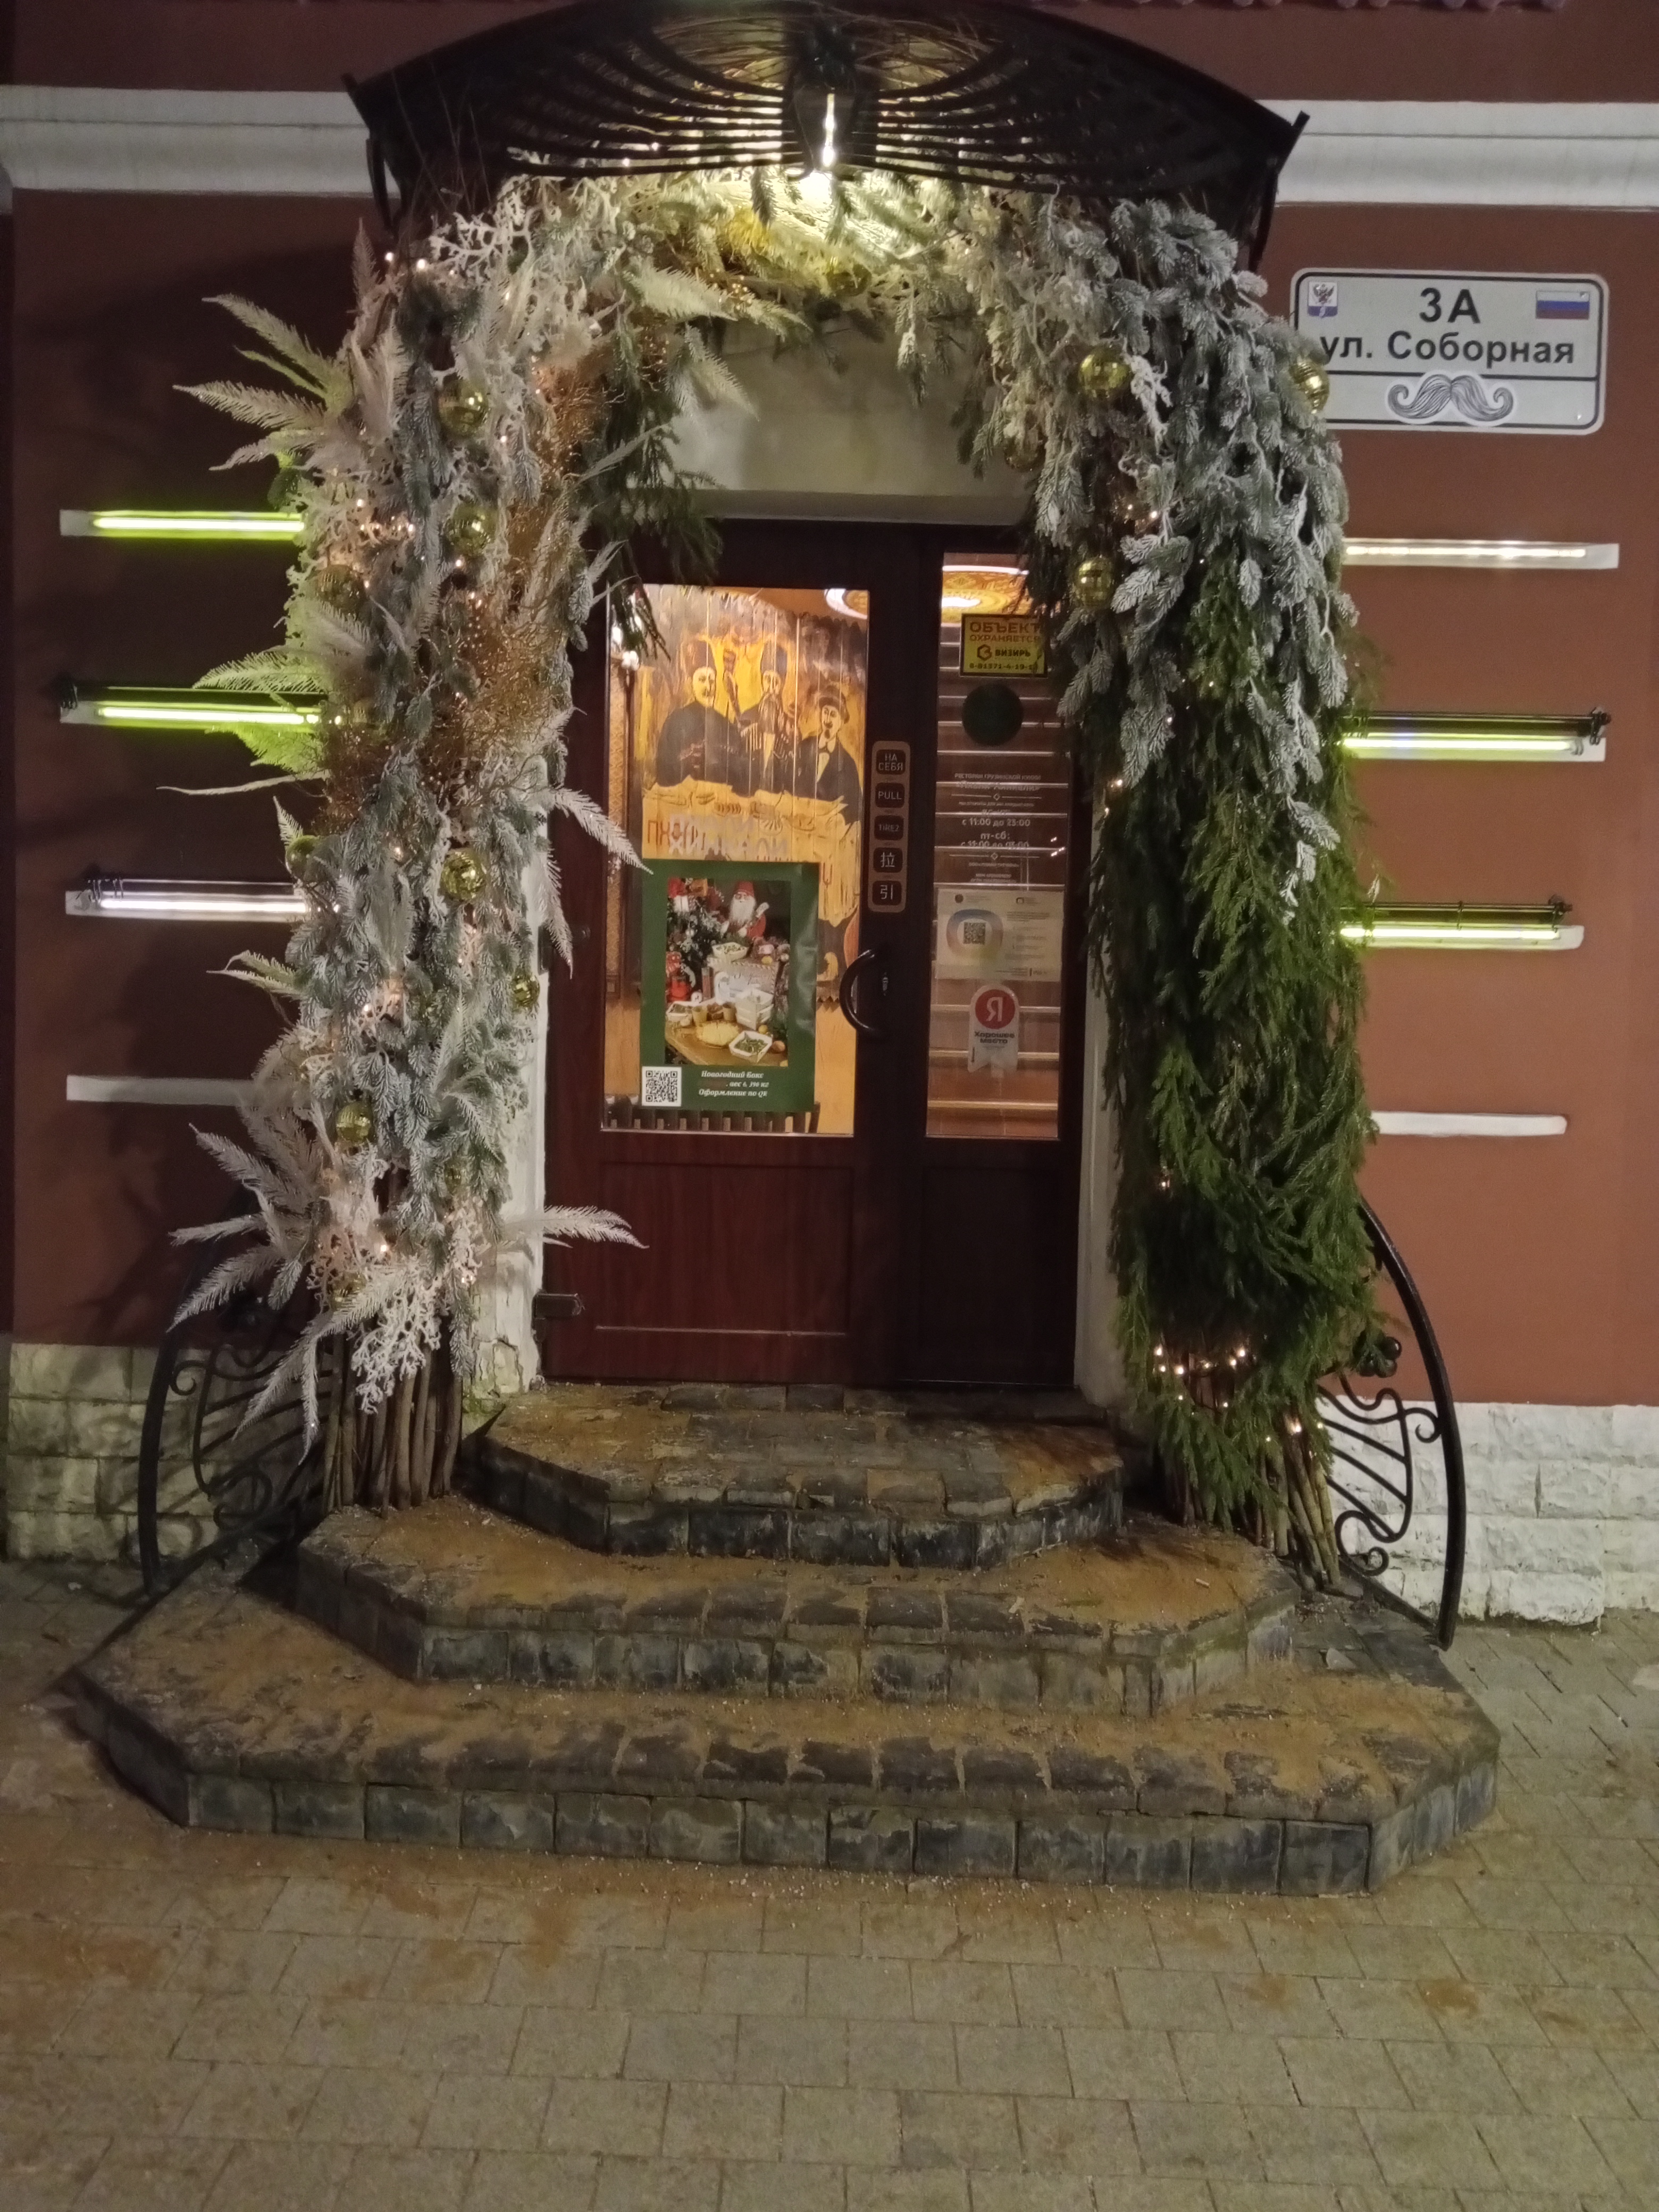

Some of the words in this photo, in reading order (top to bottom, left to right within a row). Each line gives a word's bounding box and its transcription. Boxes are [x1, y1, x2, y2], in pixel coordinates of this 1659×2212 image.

[1419, 287, 1481, 324] 3А
[1321, 336, 1373, 363] ул.
[1387, 330, 1574, 368] Соборная
[969, 622, 1041, 633] ОБЪЕКТ
[995, 647, 1031, 657] ВИЗИРЬ
[885, 753, 897, 762] НА
[878, 762, 903, 771] СЕБЯ
[877, 791, 902, 800] PULL
[1007, 818, 1030, 827] 23:00
[880, 852, 896, 868] 拉
[879, 884, 893, 900] 引
[986, 996, 1003, 1022] Я
[701, 1070, 745, 1078] Новогодний
[698, 1088, 747, 1097] Оформление
